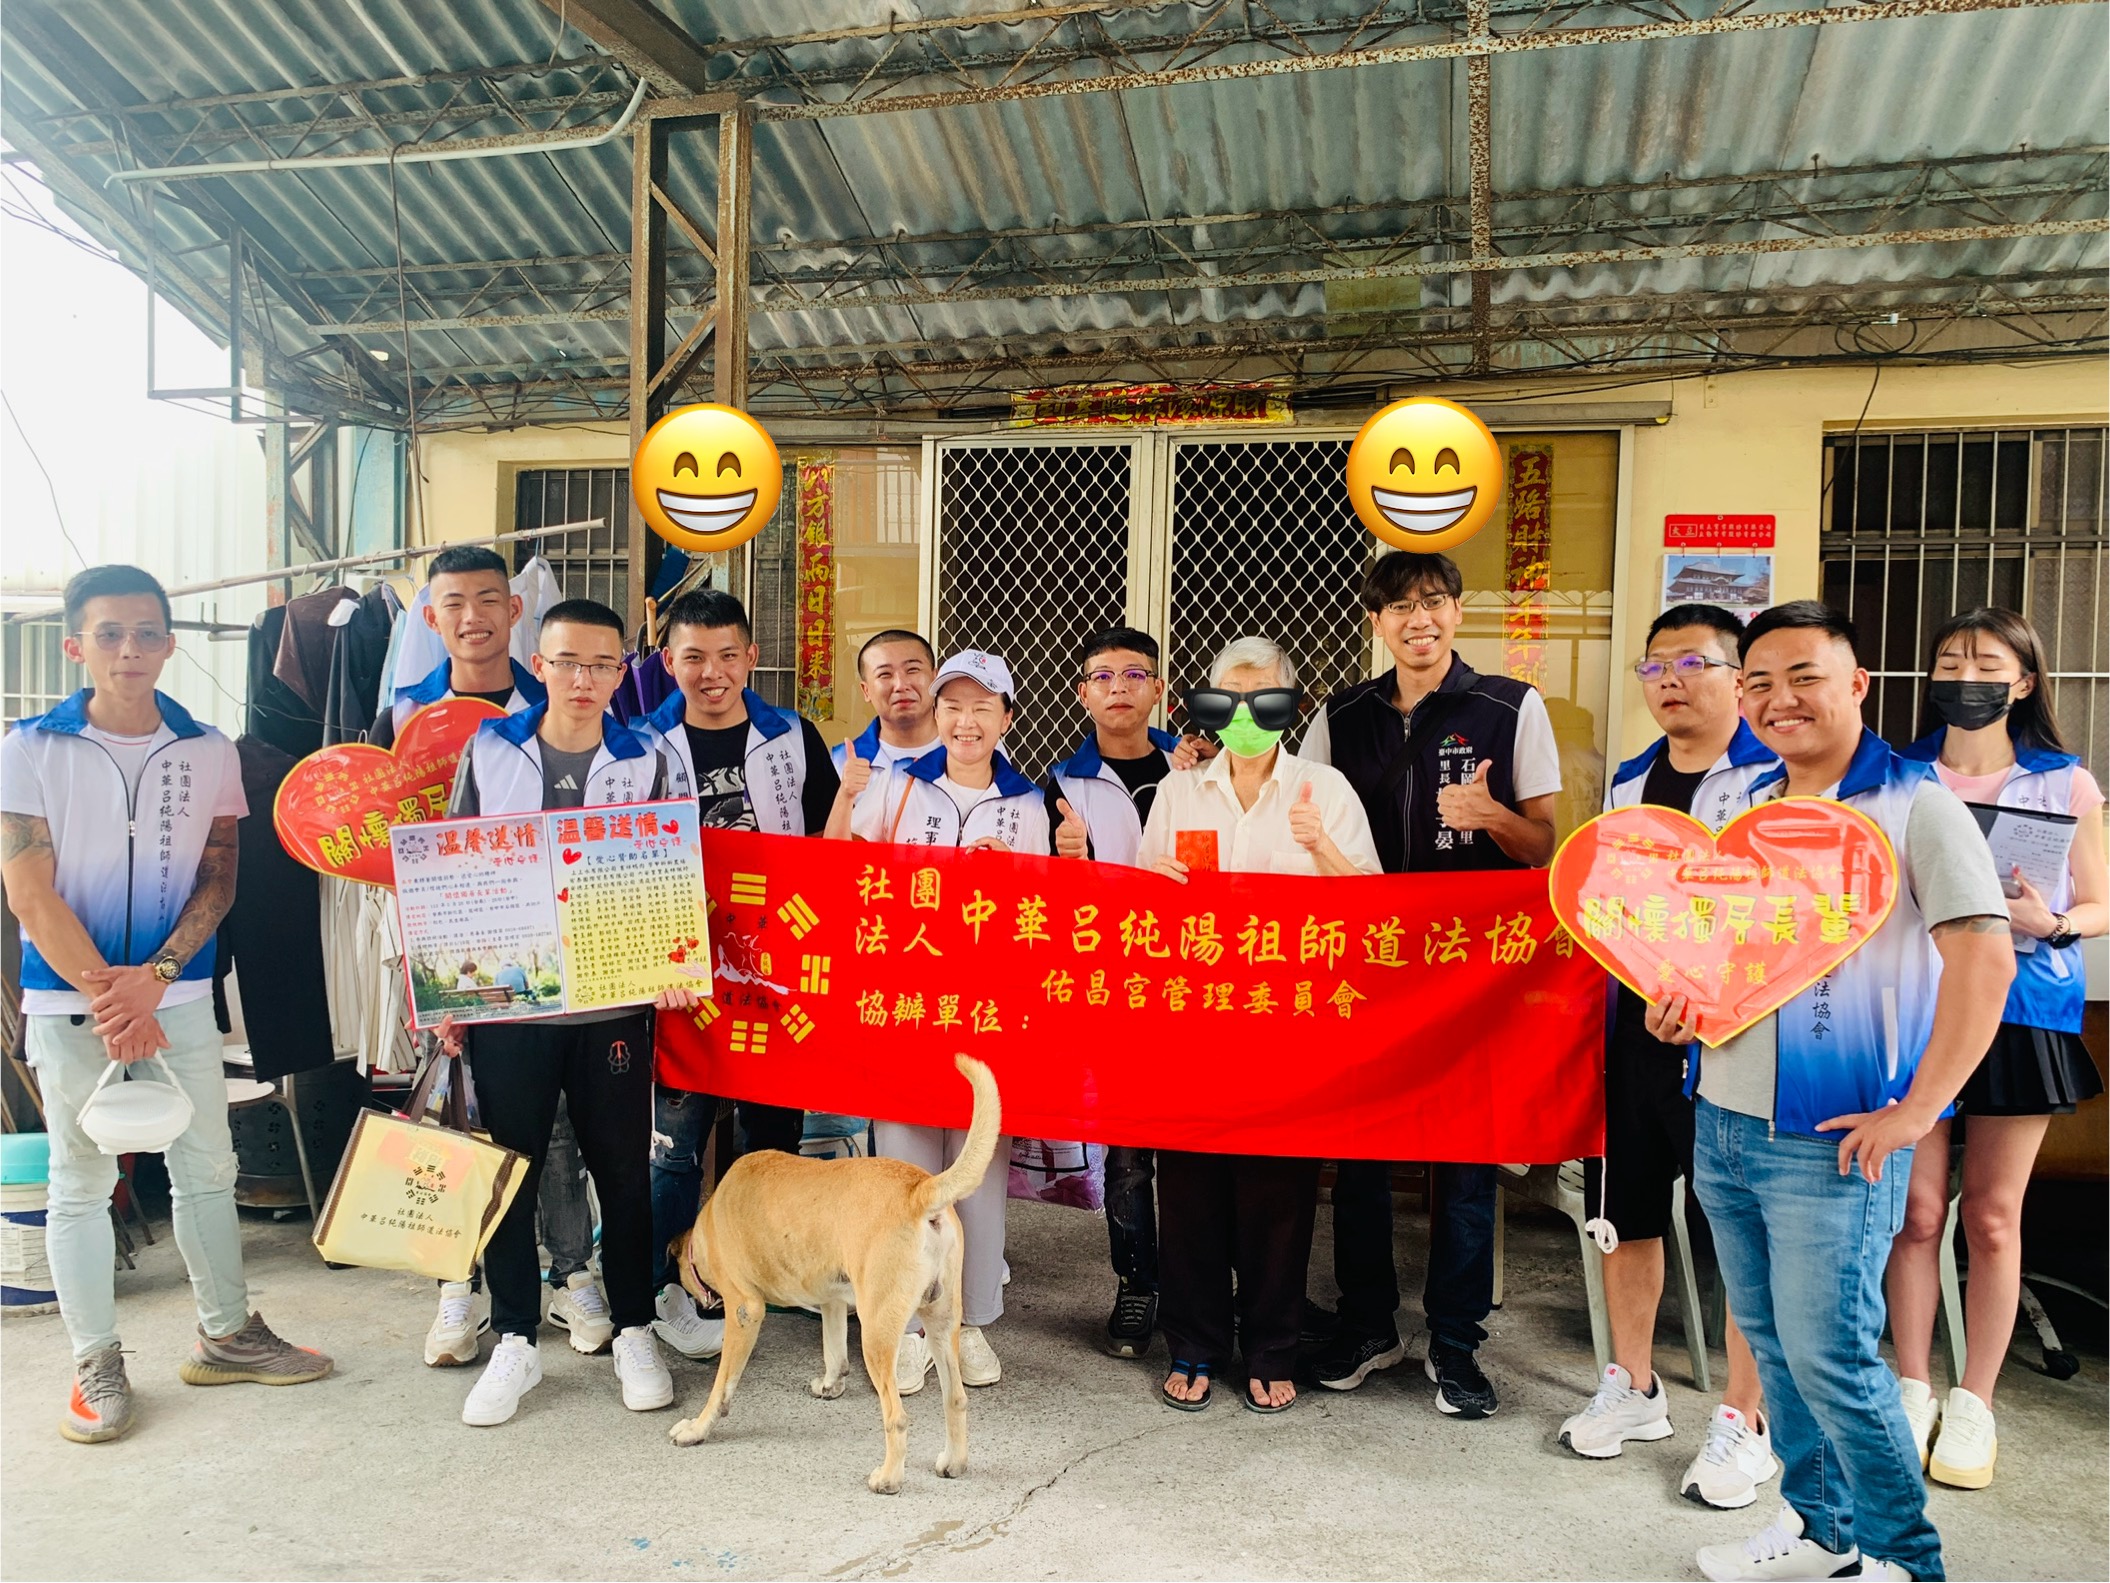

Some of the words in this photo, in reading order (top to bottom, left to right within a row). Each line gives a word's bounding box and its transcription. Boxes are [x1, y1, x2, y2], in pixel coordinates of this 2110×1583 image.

[178, 761, 192, 818] 社團法人
[766, 752, 792, 837] 中華呂純陽祖
[779, 750, 798, 801] 社團法人
[317, 776, 456, 869] 關懷獨居
[1434, 760, 1454, 850] 里長晏
[856, 864, 941, 912] 社團
[855, 916, 944, 957] 法人
[962, 889, 1577, 970] 中華呂純陽祖師道法協會
[1583, 891, 1863, 945] 關懷獨居長輩
[1041, 969, 1367, 1020] 佑昌宮管理委員會
[1656, 959, 1768, 986] 愛心守護
[1810, 974, 1832, 1041] 法協會
[397, 1207, 434, 1222] 社團法人
